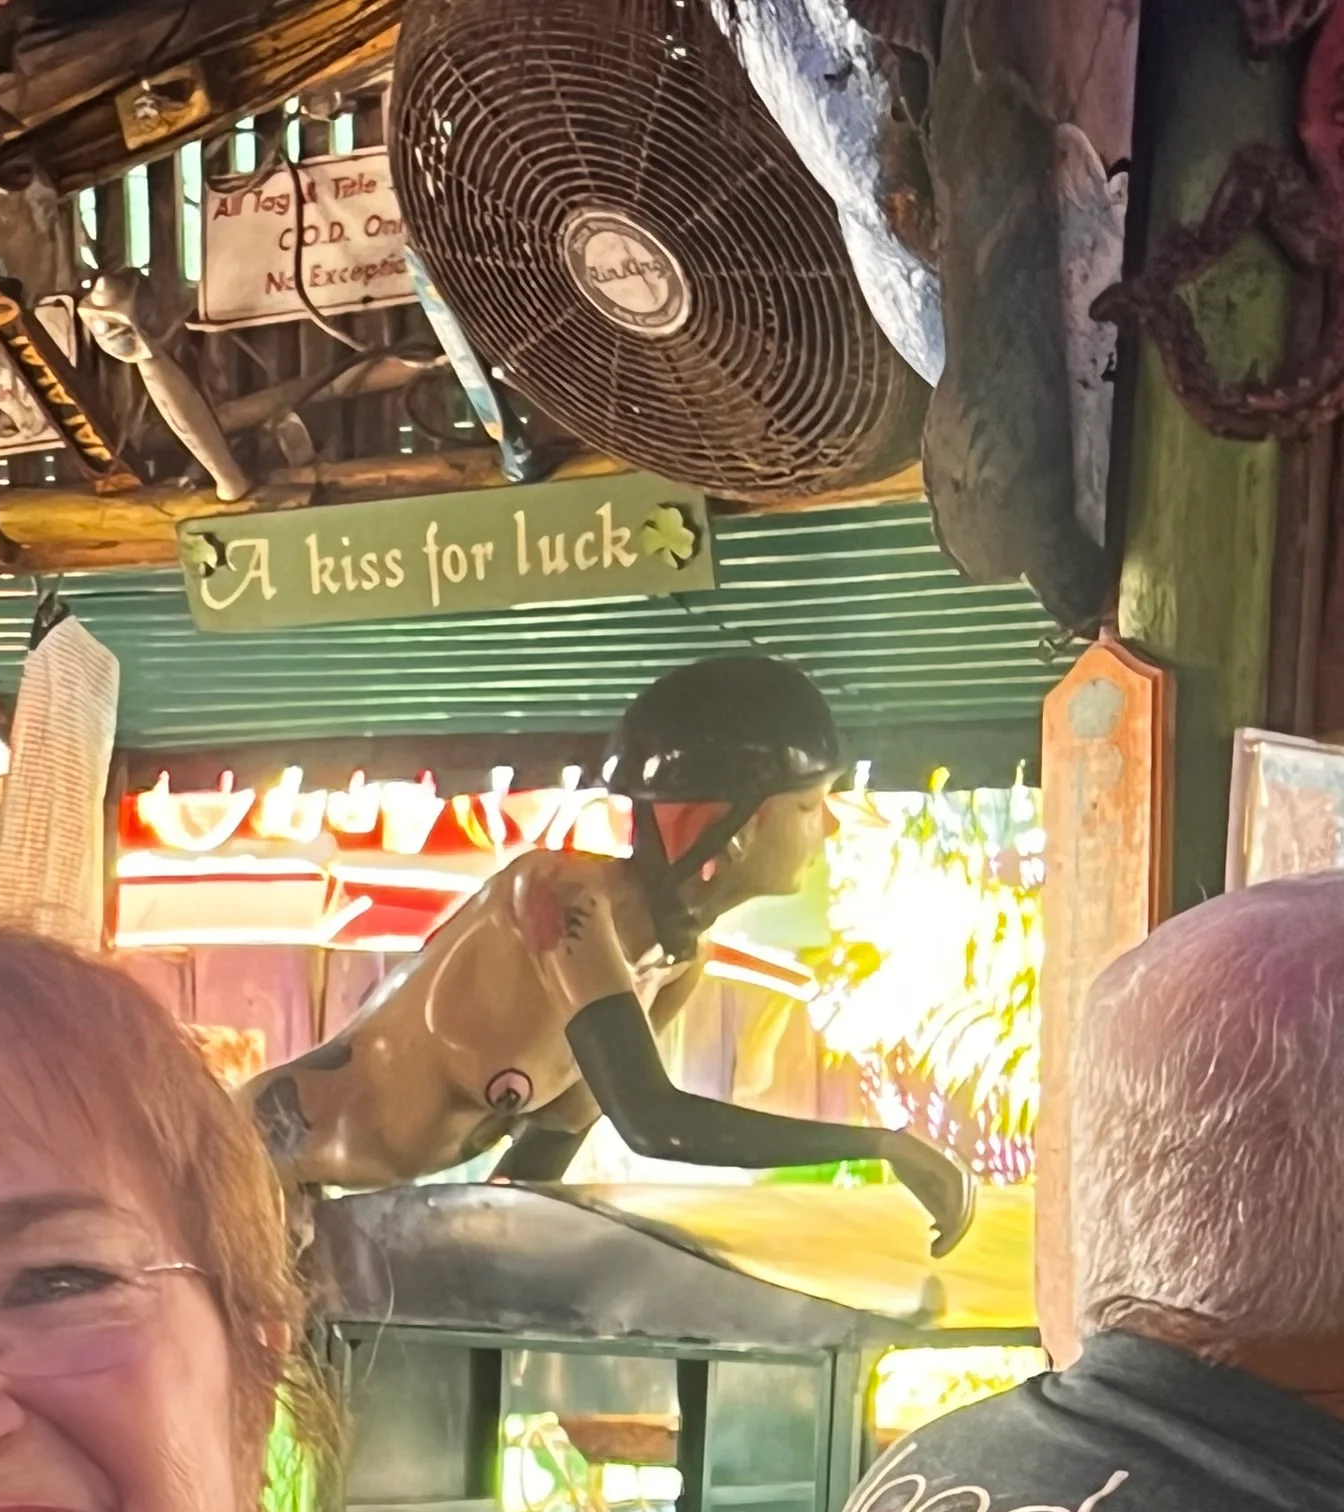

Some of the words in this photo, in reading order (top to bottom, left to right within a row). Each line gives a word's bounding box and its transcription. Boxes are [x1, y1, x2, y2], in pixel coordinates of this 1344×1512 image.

[279, 221, 350, 251] CO.D.
[364, 213, 406, 238] Onl
[200, 538, 279, 610] A
[305, 533, 406, 596] kiss
[422, 521, 495, 607] for
[514, 501, 640, 577] luck
